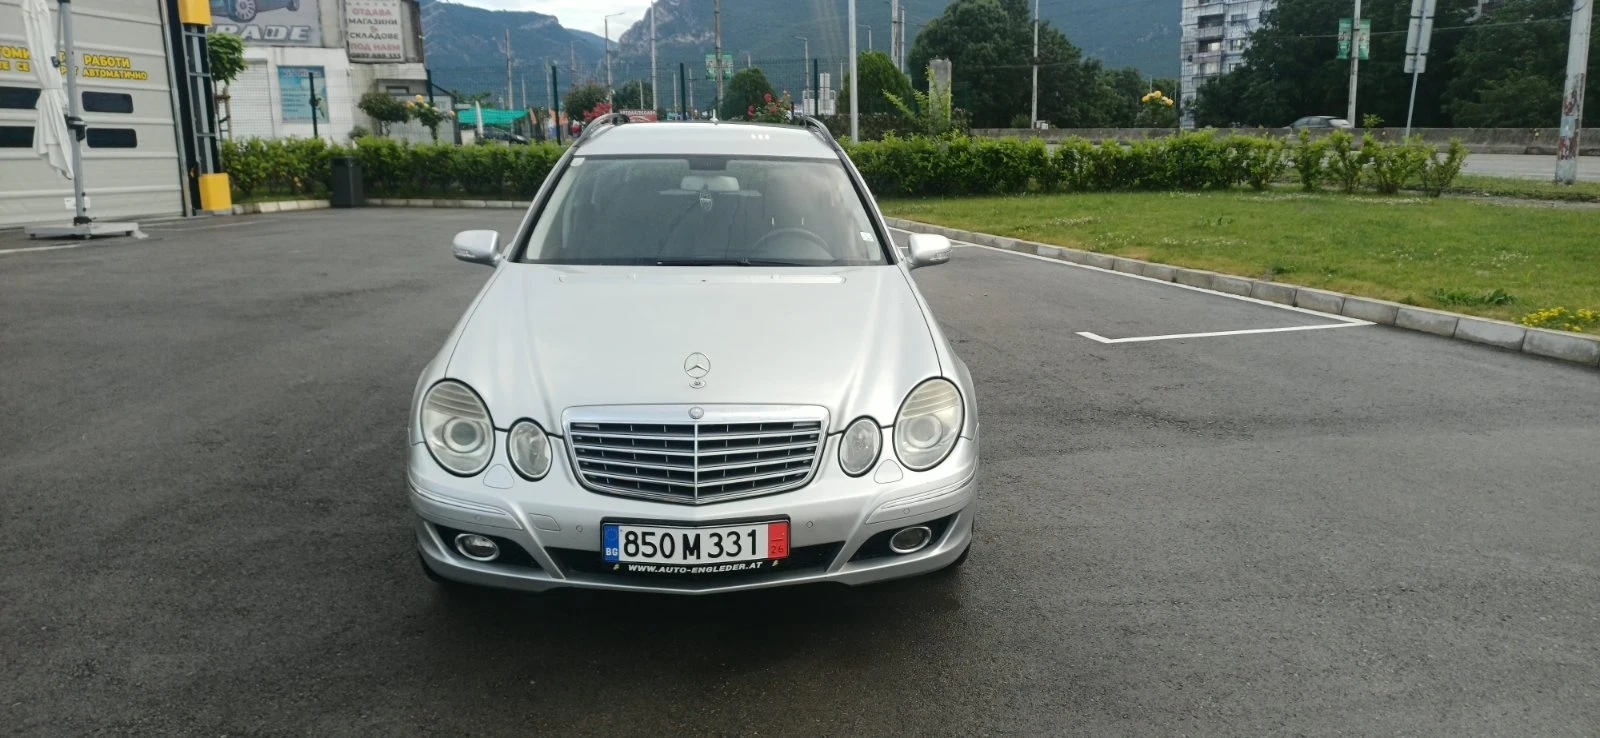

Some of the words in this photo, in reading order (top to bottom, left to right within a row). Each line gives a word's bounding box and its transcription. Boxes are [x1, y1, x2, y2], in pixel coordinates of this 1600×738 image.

[350, 32, 399, 40] СКЛАДОВЕ
[84, 54, 130, 68] РАБОТИ
[83, 68, 147, 80] АВТОМАТИЧНО
[623, 531, 675, 559] 850
[682, 533, 701, 560] M
[707, 529, 757, 559] 331
[771, 545, 784, 554] 26
[628, 561, 763, 574] WWW.AUTO-ENGLEDER.AT
